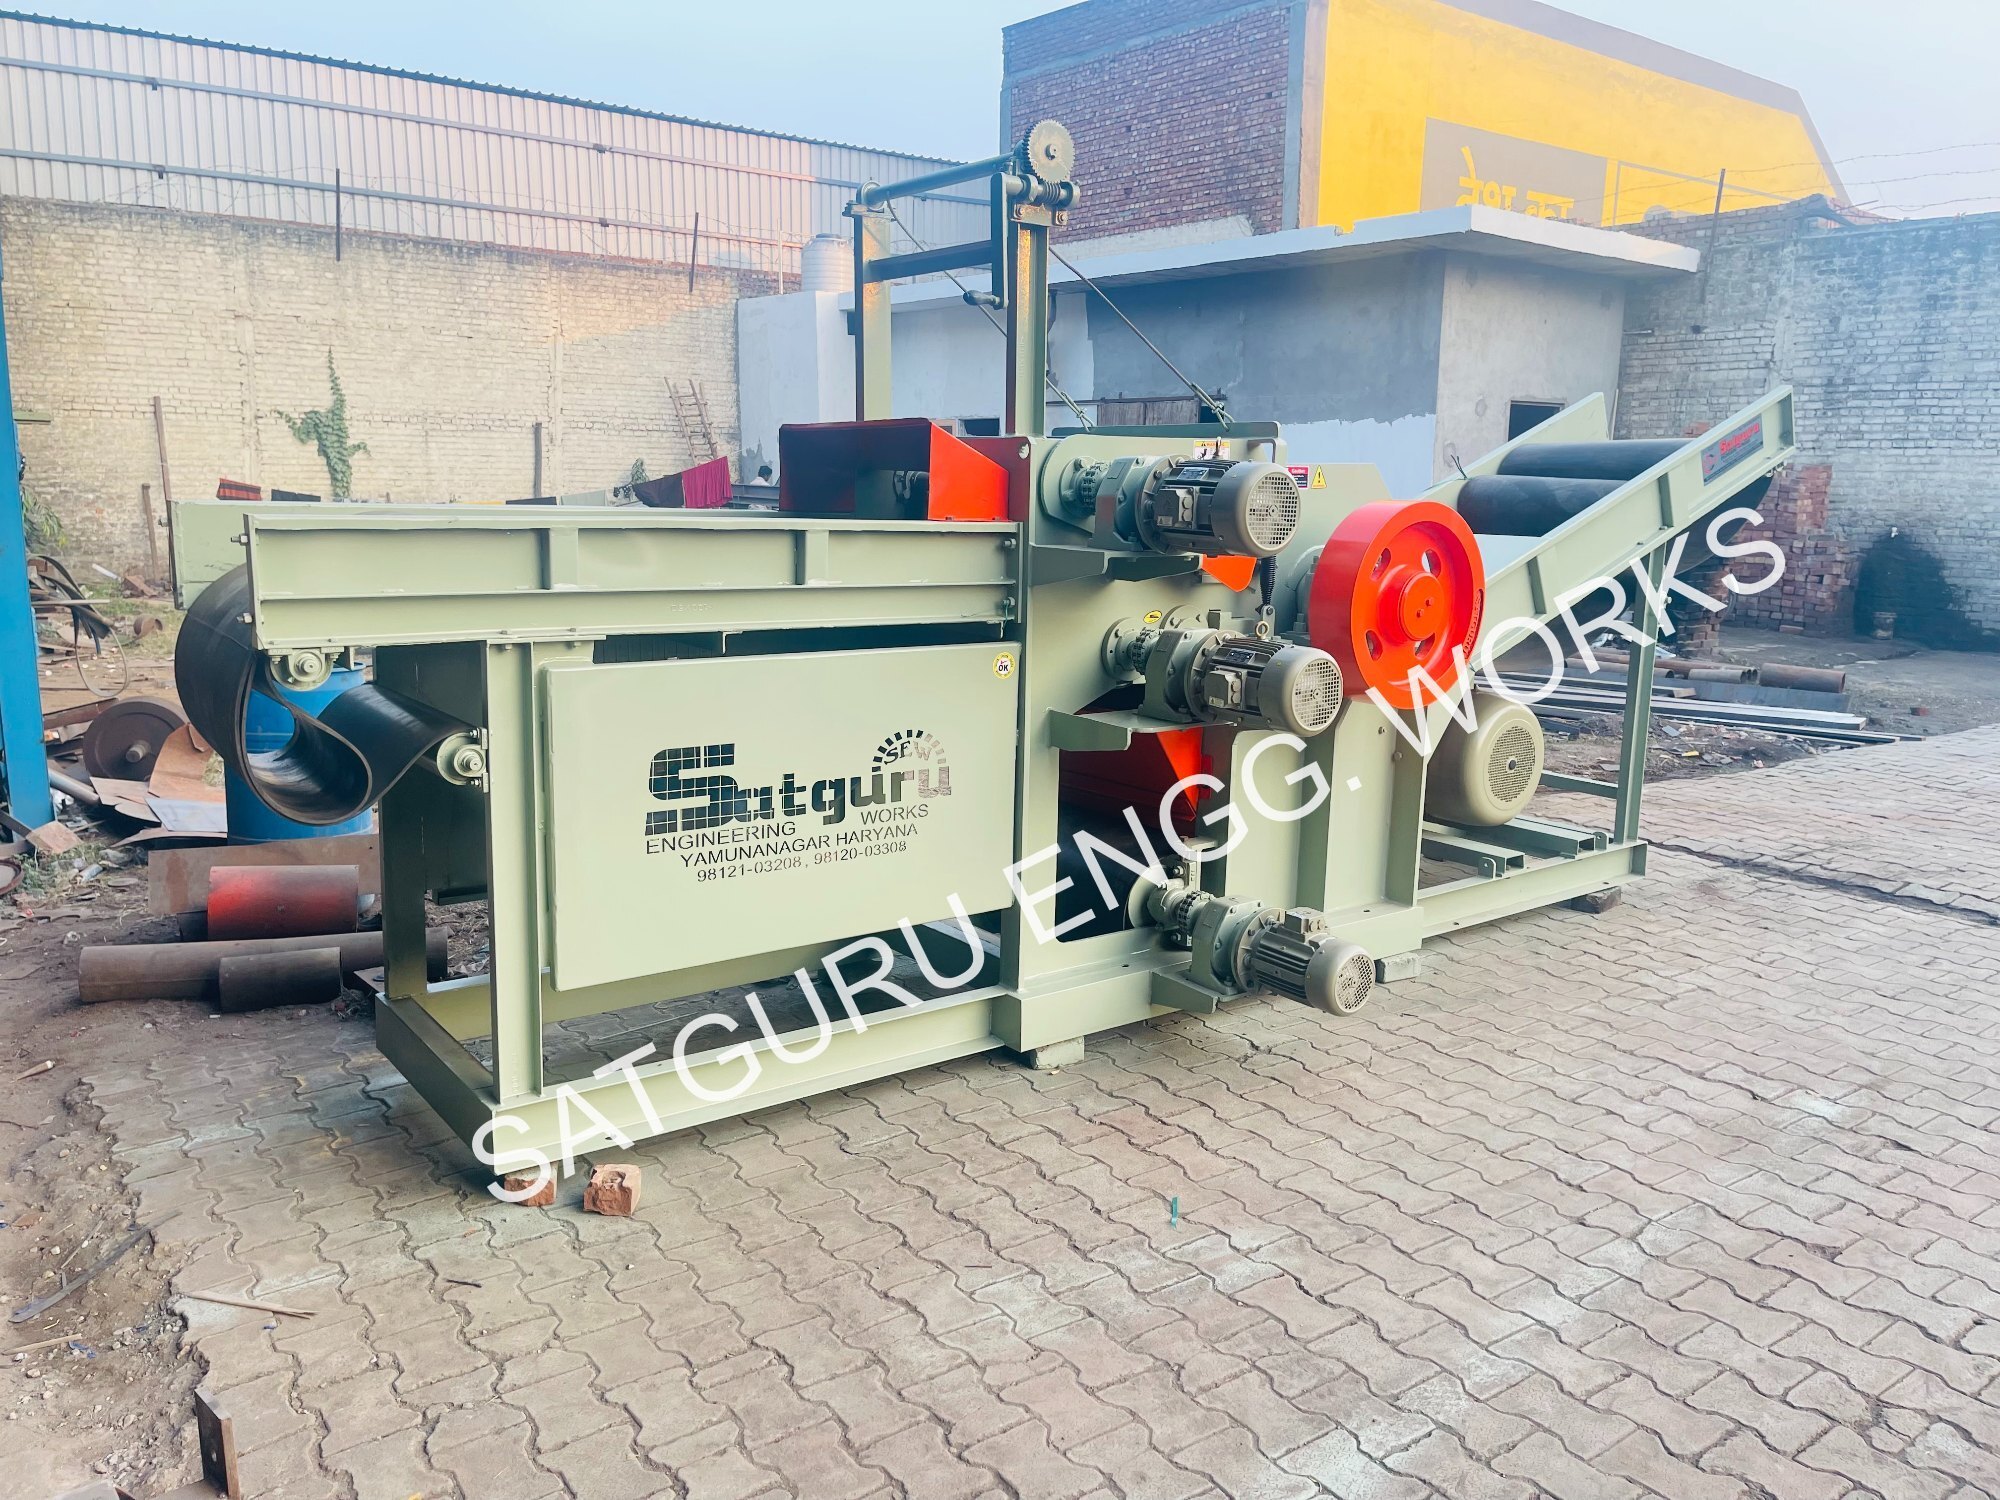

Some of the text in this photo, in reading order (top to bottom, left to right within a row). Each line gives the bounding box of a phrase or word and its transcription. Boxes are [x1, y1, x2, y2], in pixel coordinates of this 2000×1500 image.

[998, 664, 1009, 672] OK
[884, 740, 932, 765] SEW
[645, 743, 952, 836] Satguru
[646, 804, 929, 854] ENGINEERING WORKS
[680, 822, 919, 868] YAMUNANAGAR HARYANA
[814, 841, 907, 865] 98120-03308
